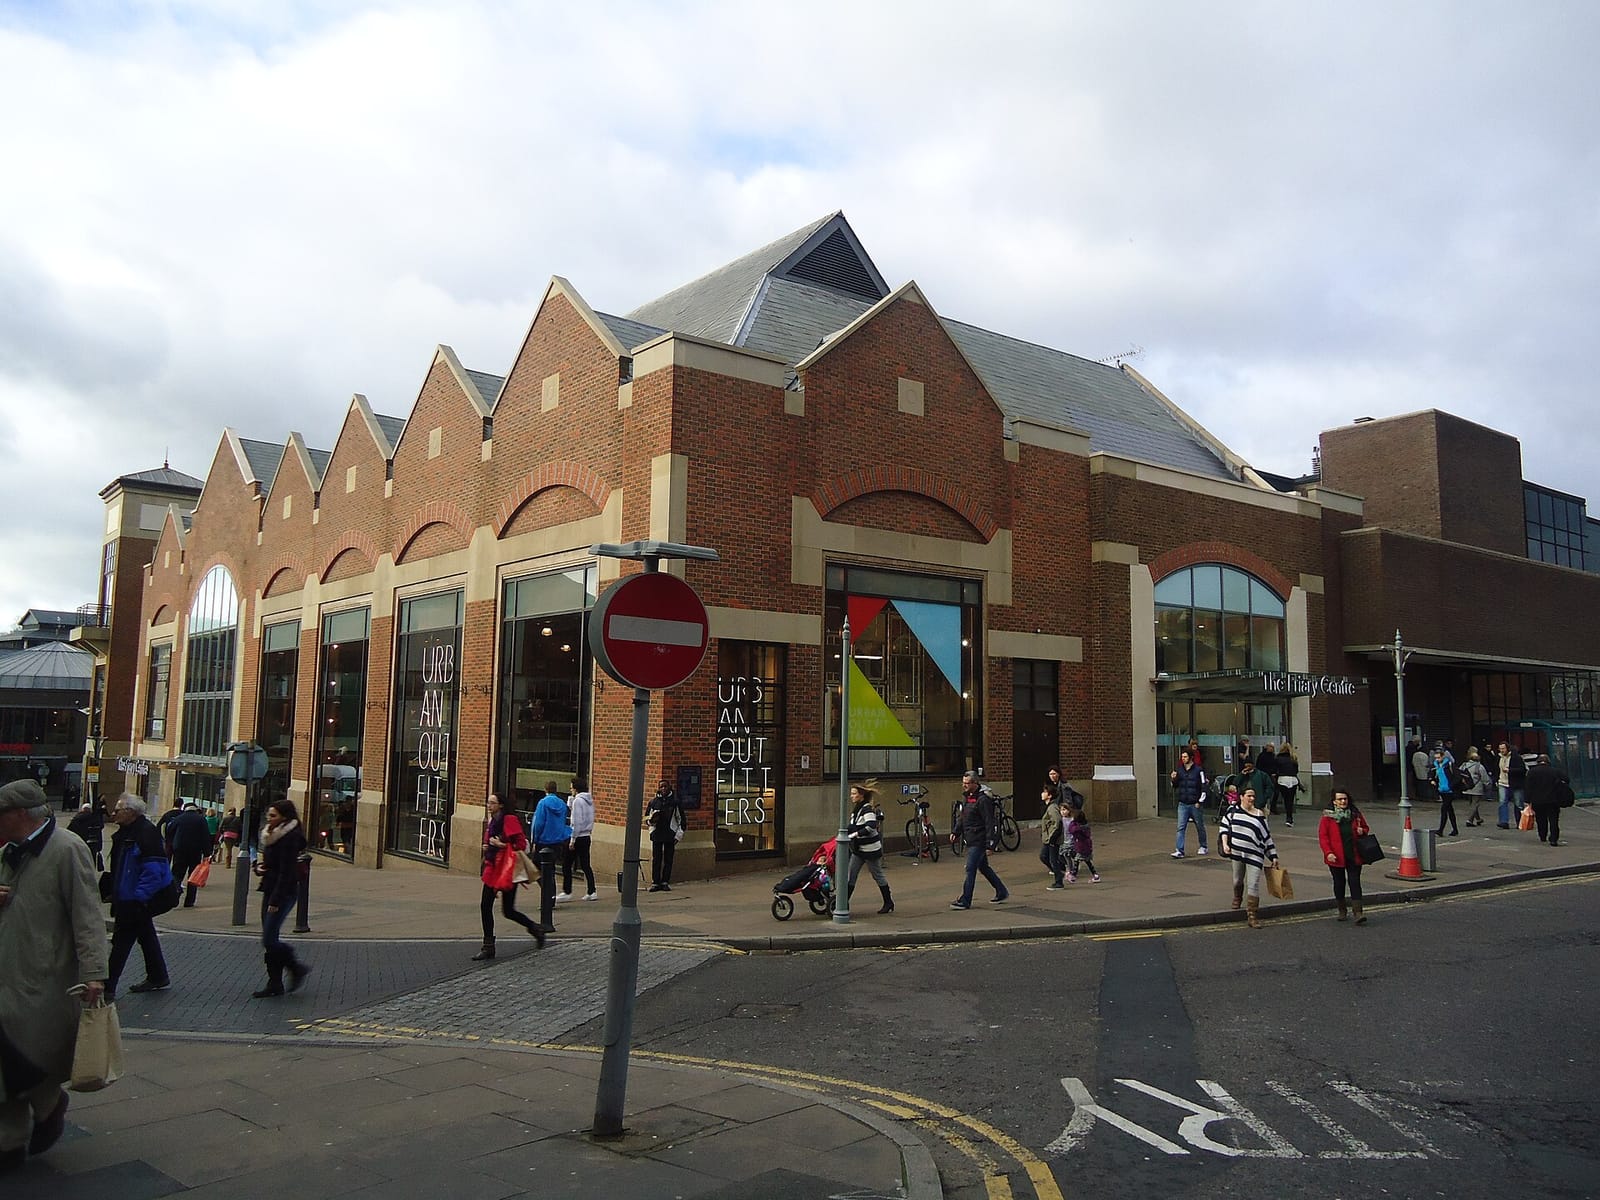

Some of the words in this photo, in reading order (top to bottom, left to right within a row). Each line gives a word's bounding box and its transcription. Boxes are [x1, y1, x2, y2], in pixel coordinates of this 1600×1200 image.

[422, 643, 455, 685] URB
[1263, 671, 1284, 692] The
[419, 689, 444, 729] AN
[717, 708, 750, 735] AN
[717, 737, 768, 764] OUT
[716, 767, 771, 795] FITT
[725, 797, 766, 826] ERS
